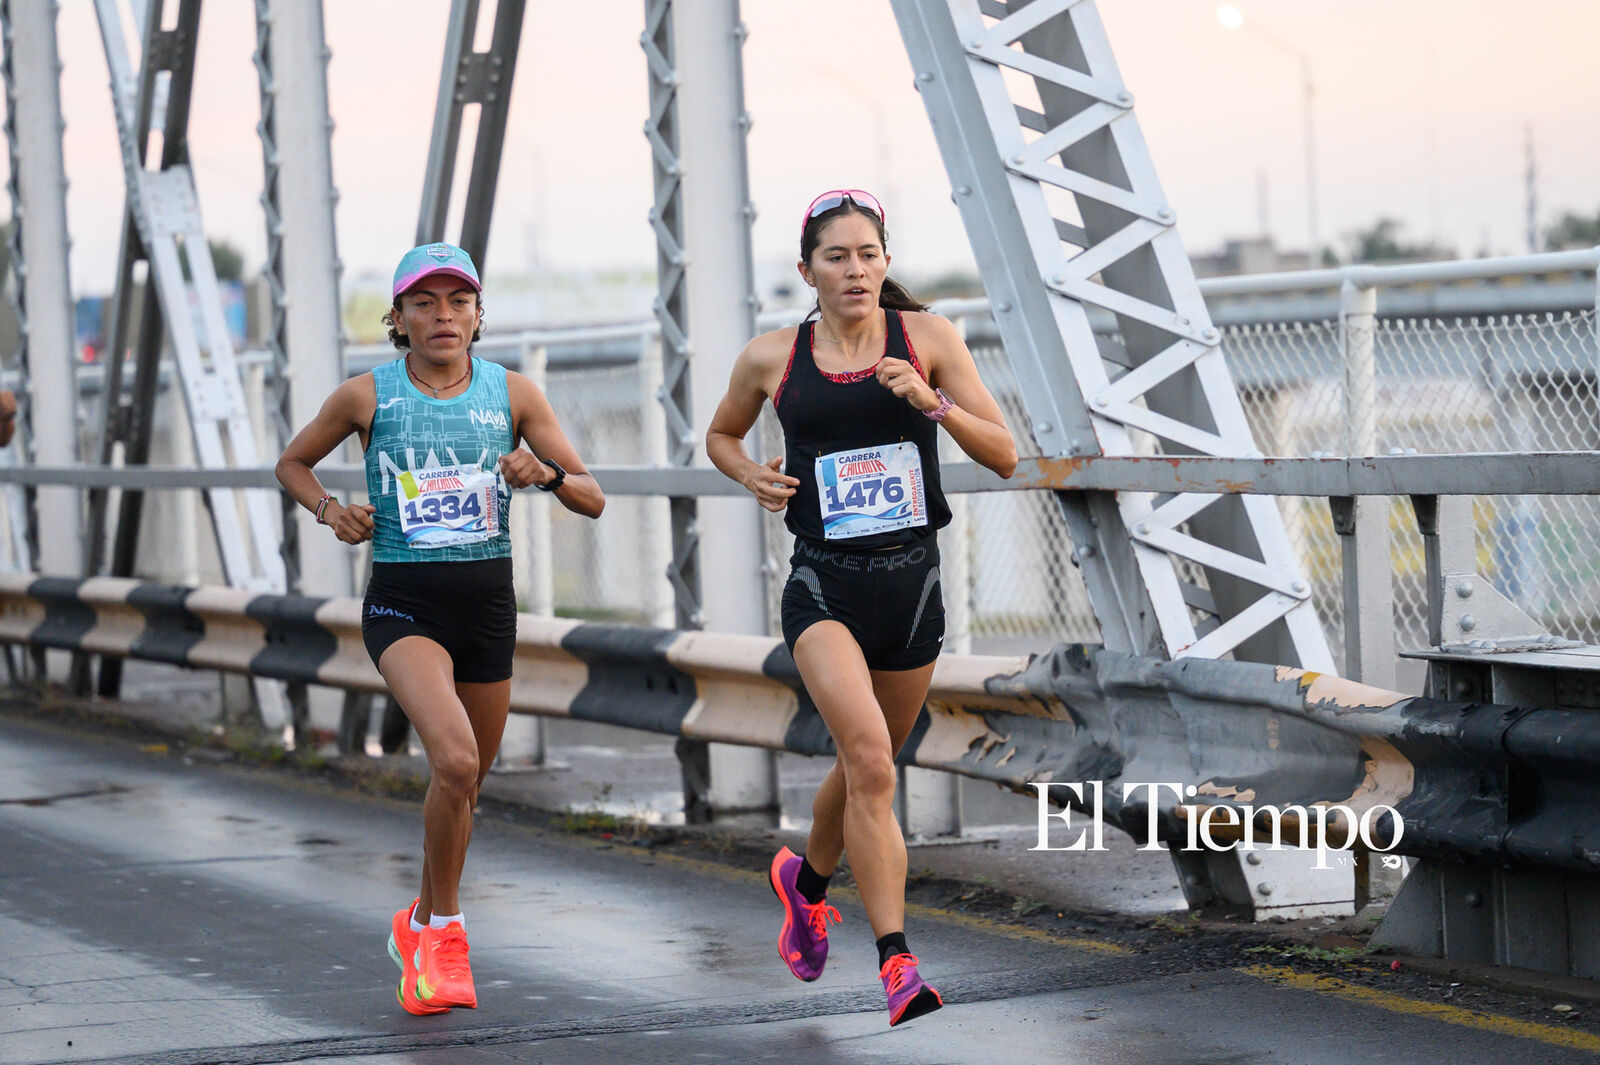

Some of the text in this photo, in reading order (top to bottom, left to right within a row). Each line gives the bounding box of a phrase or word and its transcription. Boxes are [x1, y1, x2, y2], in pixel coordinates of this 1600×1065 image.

[839, 451, 881, 464] CARRERA
[419, 469, 460, 481] CARRERA
[838, 459, 887, 479] CHILCHOTA
[419, 477, 465, 494] CHILCHOTA
[826, 476, 905, 513] 1476
[404, 492, 482, 526] 1334
